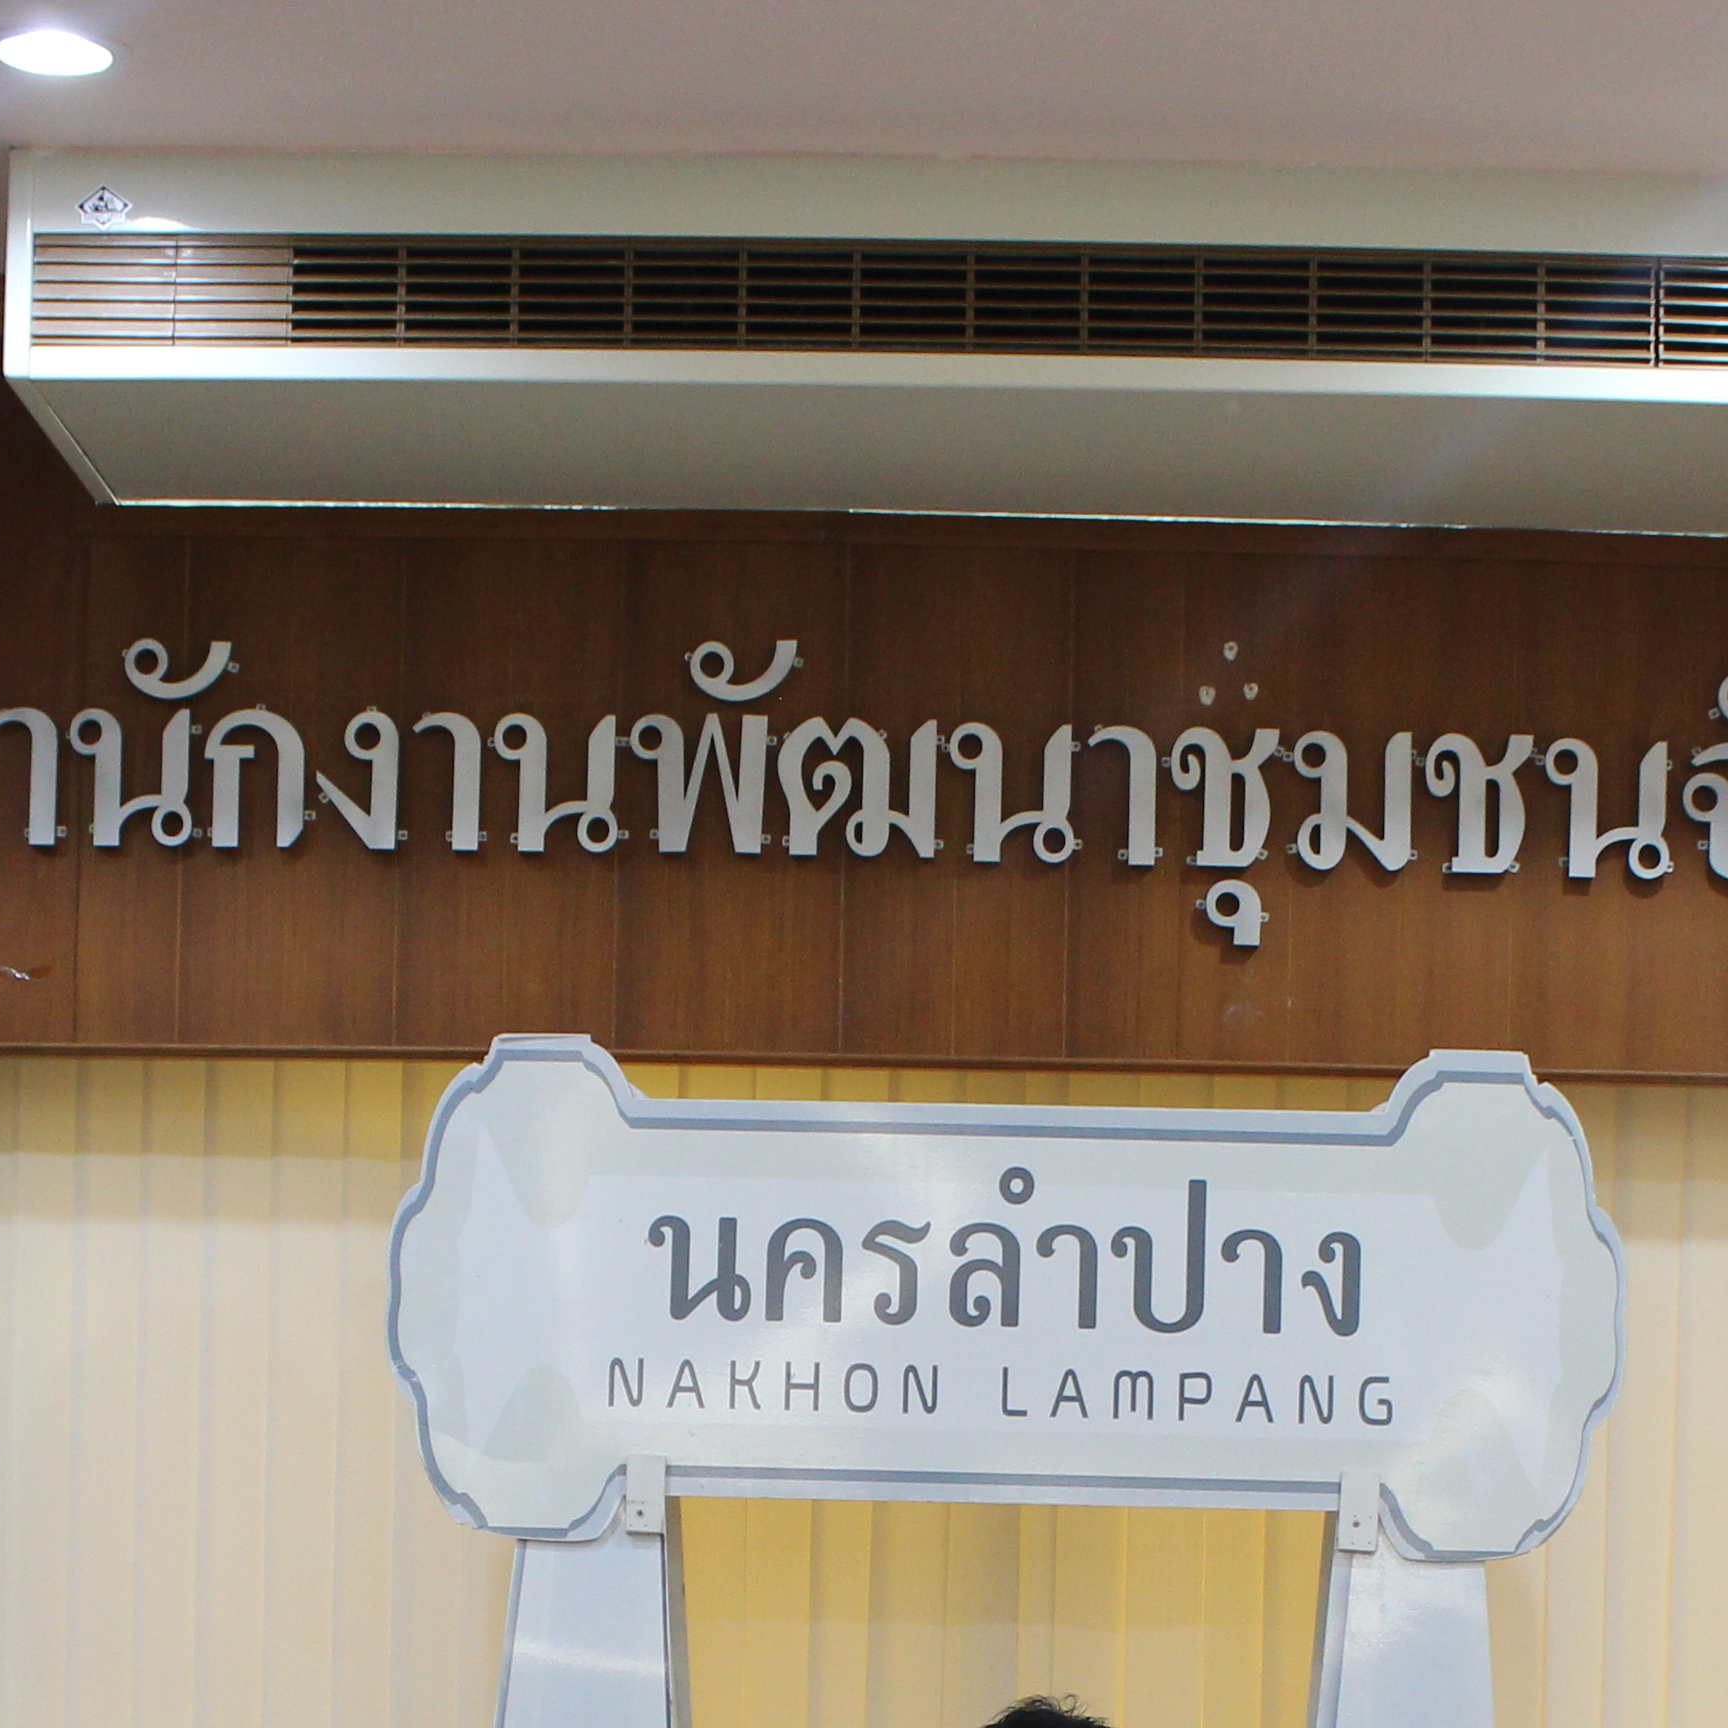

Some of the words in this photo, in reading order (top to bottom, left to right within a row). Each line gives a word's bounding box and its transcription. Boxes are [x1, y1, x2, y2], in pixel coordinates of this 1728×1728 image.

[648, 1166, 1363, 1336] นครลำปาง
[607, 1356, 941, 1415] NAKHON
[1001, 1366, 1394, 1426] LAMPANG
